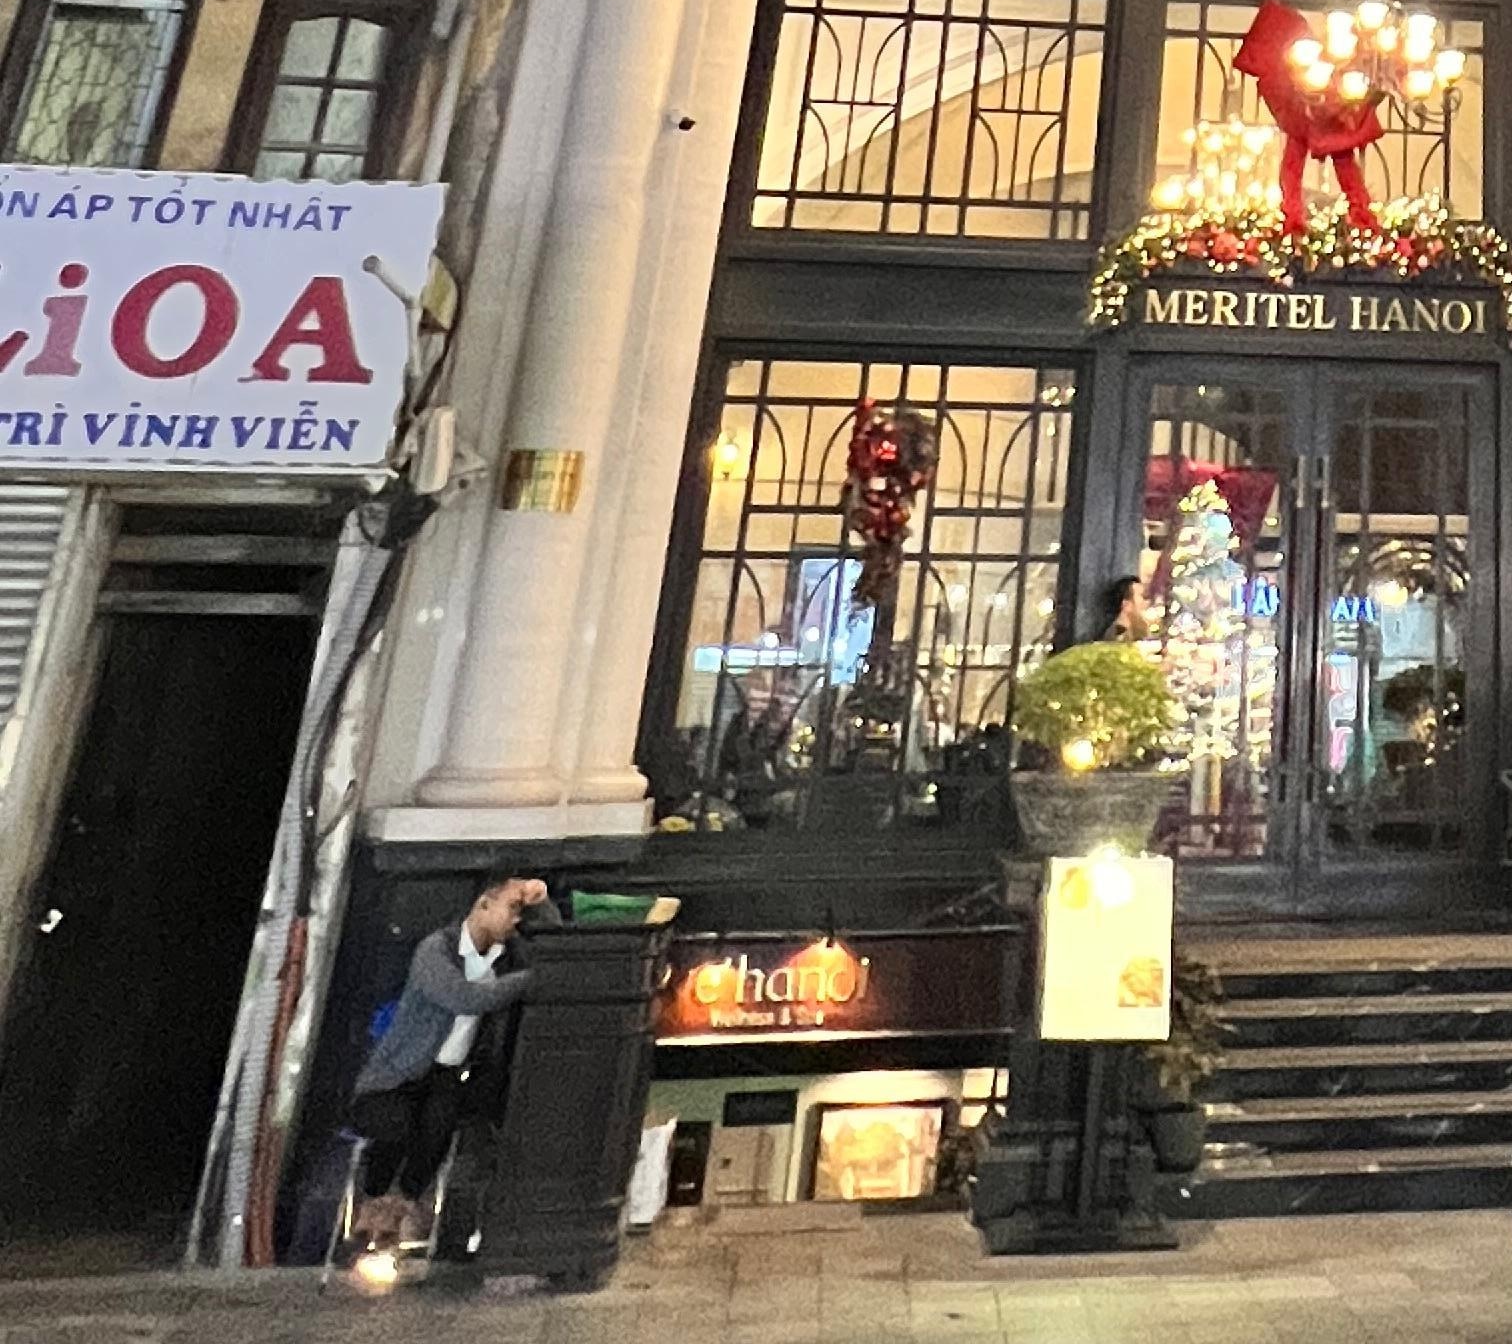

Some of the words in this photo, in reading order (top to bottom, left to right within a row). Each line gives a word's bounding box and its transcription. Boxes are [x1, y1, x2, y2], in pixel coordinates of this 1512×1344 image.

[0, 175, 40, 218] N
[47, 185, 114, 219] ÁP
[0, 263, 374, 385] iOA
[1145, 289, 1335, 330] MERITEL
[1351, 296, 1486, 333] HANOI
[231, 400, 361, 451] VIỄN
